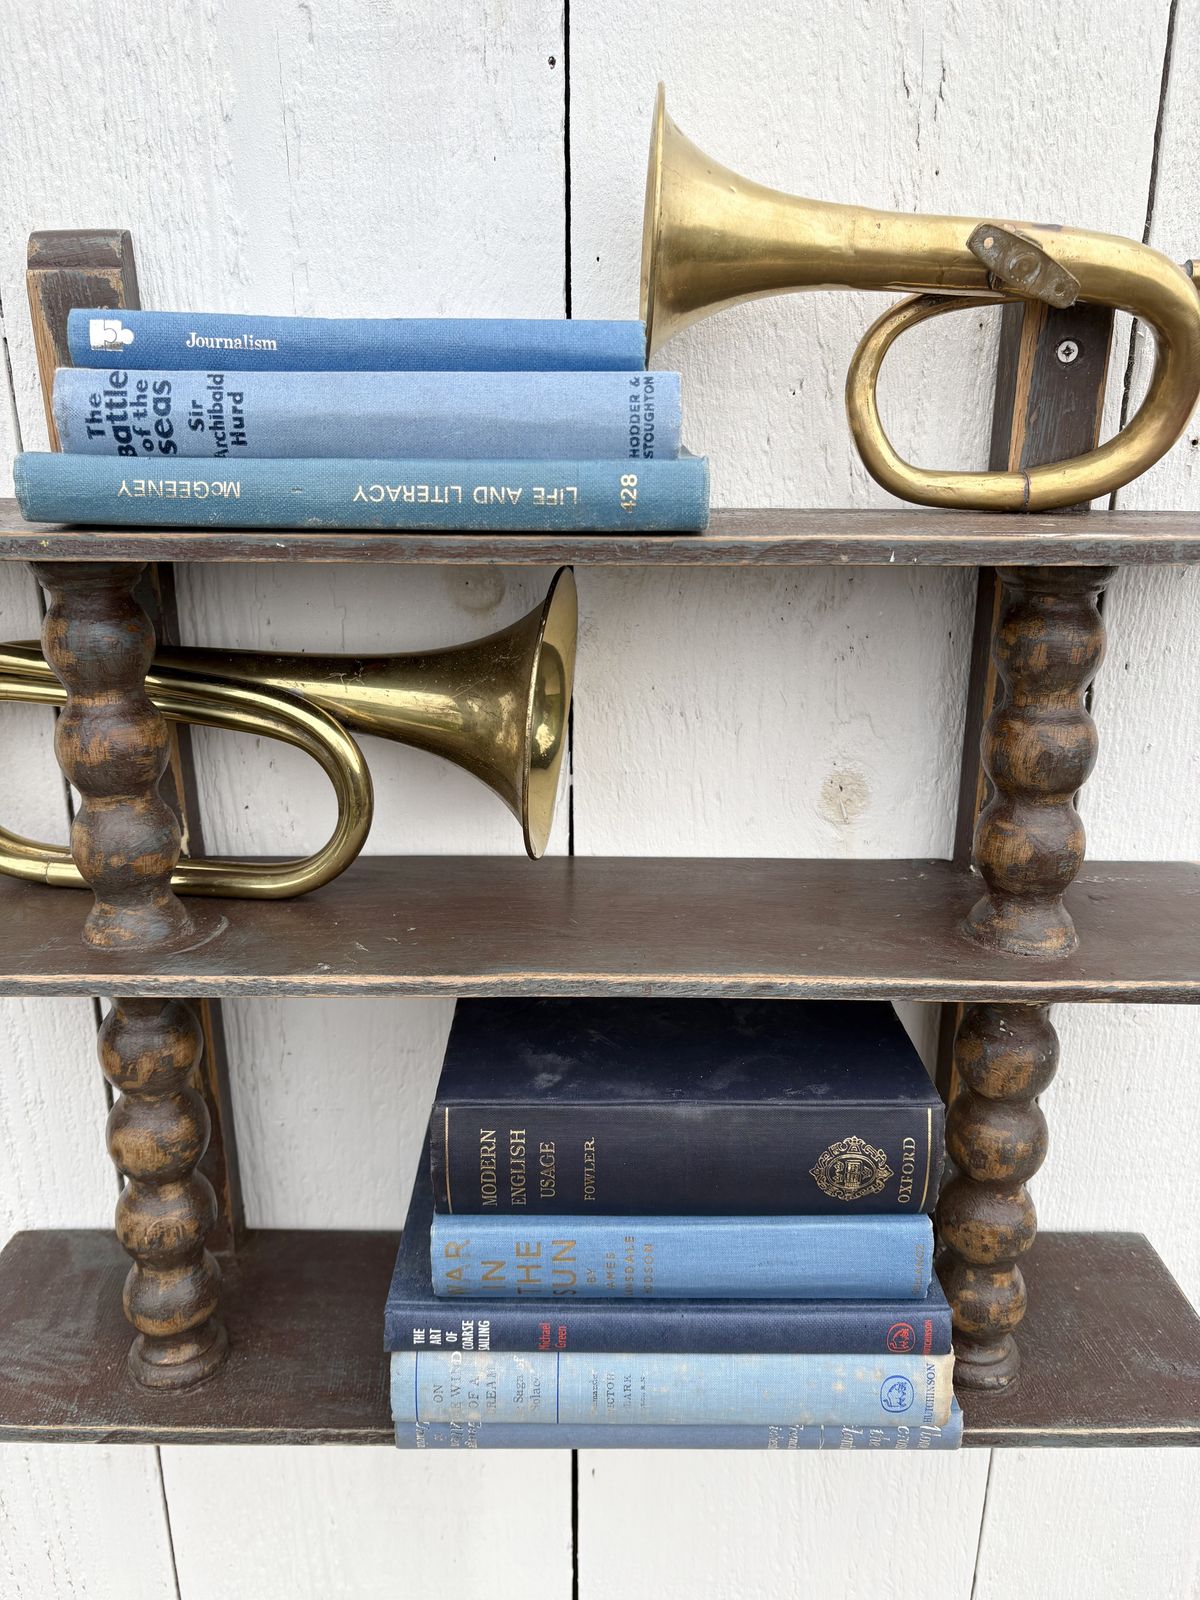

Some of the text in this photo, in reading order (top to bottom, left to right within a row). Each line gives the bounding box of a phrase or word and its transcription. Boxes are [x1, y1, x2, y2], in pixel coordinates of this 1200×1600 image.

[186, 333, 278, 351] Journalism
[85, 393, 105, 440] The
[104, 371, 138, 457] Battle
[129, 379, 155, 452] of the
[153, 380, 177, 455] seas
[188, 399, 204, 432] Sir
[207, 373, 228, 458] Archibald
[227, 392, 247, 446] Hurd
[629, 377, 641, 458] HODDER &
[643, 376, 654, 459] STOUGHTON
[352, 485, 577, 505] LIFE AND LITERACY
[621, 474, 637, 513] 428
[480, 1129, 496, 1207] MODERN
[510, 1129, 526, 1206] ENGLISH
[540, 1142, 555, 1198] USAGE
[584, 1136, 596, 1201] FOWLER
[897, 1137, 916, 1204] OXFORD
[444, 1240, 467, 1296] WAR
[481, 1260, 506, 1290] IN
[516, 1241, 542, 1295] THE
[552, 1239, 577, 1297] SUN
[413, 1328, 425, 1345] THE
[429, 1328, 442, 1345] ART
[446, 1330, 457, 1343] OF
[462, 1320, 474, 1350] COARSE
[478, 1320, 490, 1351] SAILING
[537, 1322, 550, 1351] Michael
[555, 1325, 568, 1349] Green
[433, 1384, 444, 1403] ON
[468, 1391, 479, 1409] OF
[923, 1363, 936, 1424] HUTCHINSON
